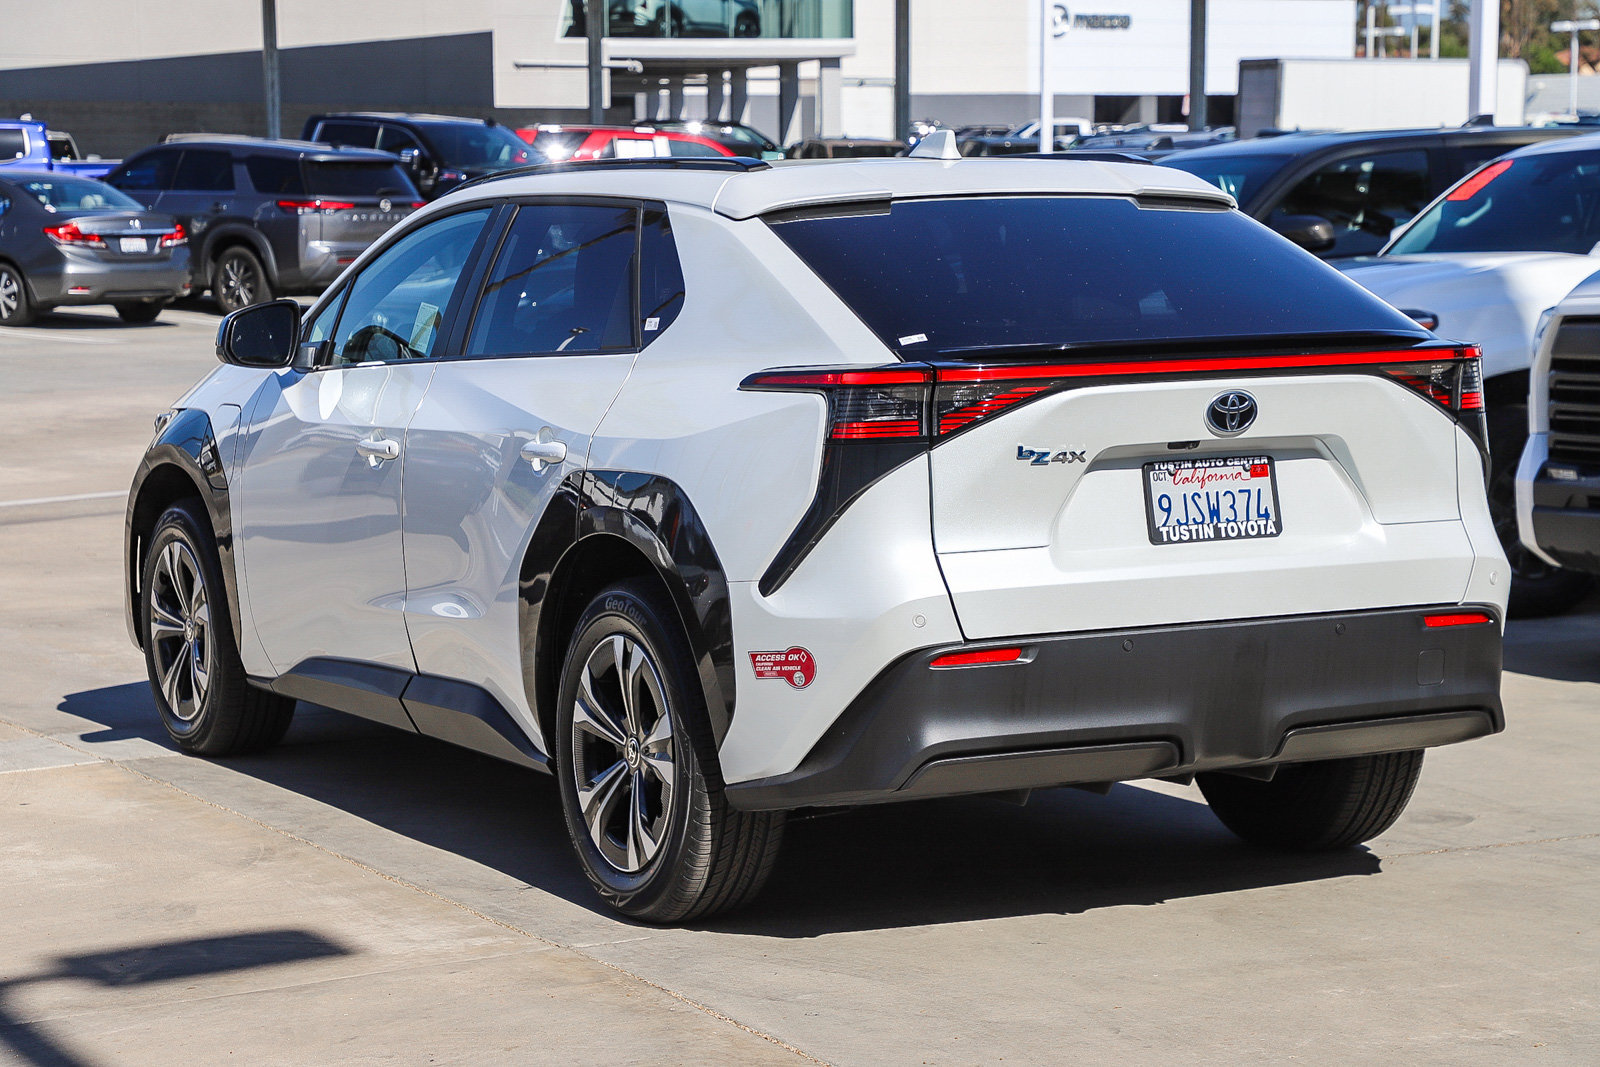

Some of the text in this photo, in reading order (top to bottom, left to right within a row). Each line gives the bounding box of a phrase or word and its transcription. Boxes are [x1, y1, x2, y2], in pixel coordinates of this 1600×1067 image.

[1154, 457, 1269, 471] TUSTIN AUTO CENTER
[1172, 467, 1251, 489] California
[1158, 488, 1270, 527] 9JSW374
[1159, 519, 1277, 541] TUSTIN TOYOTA
